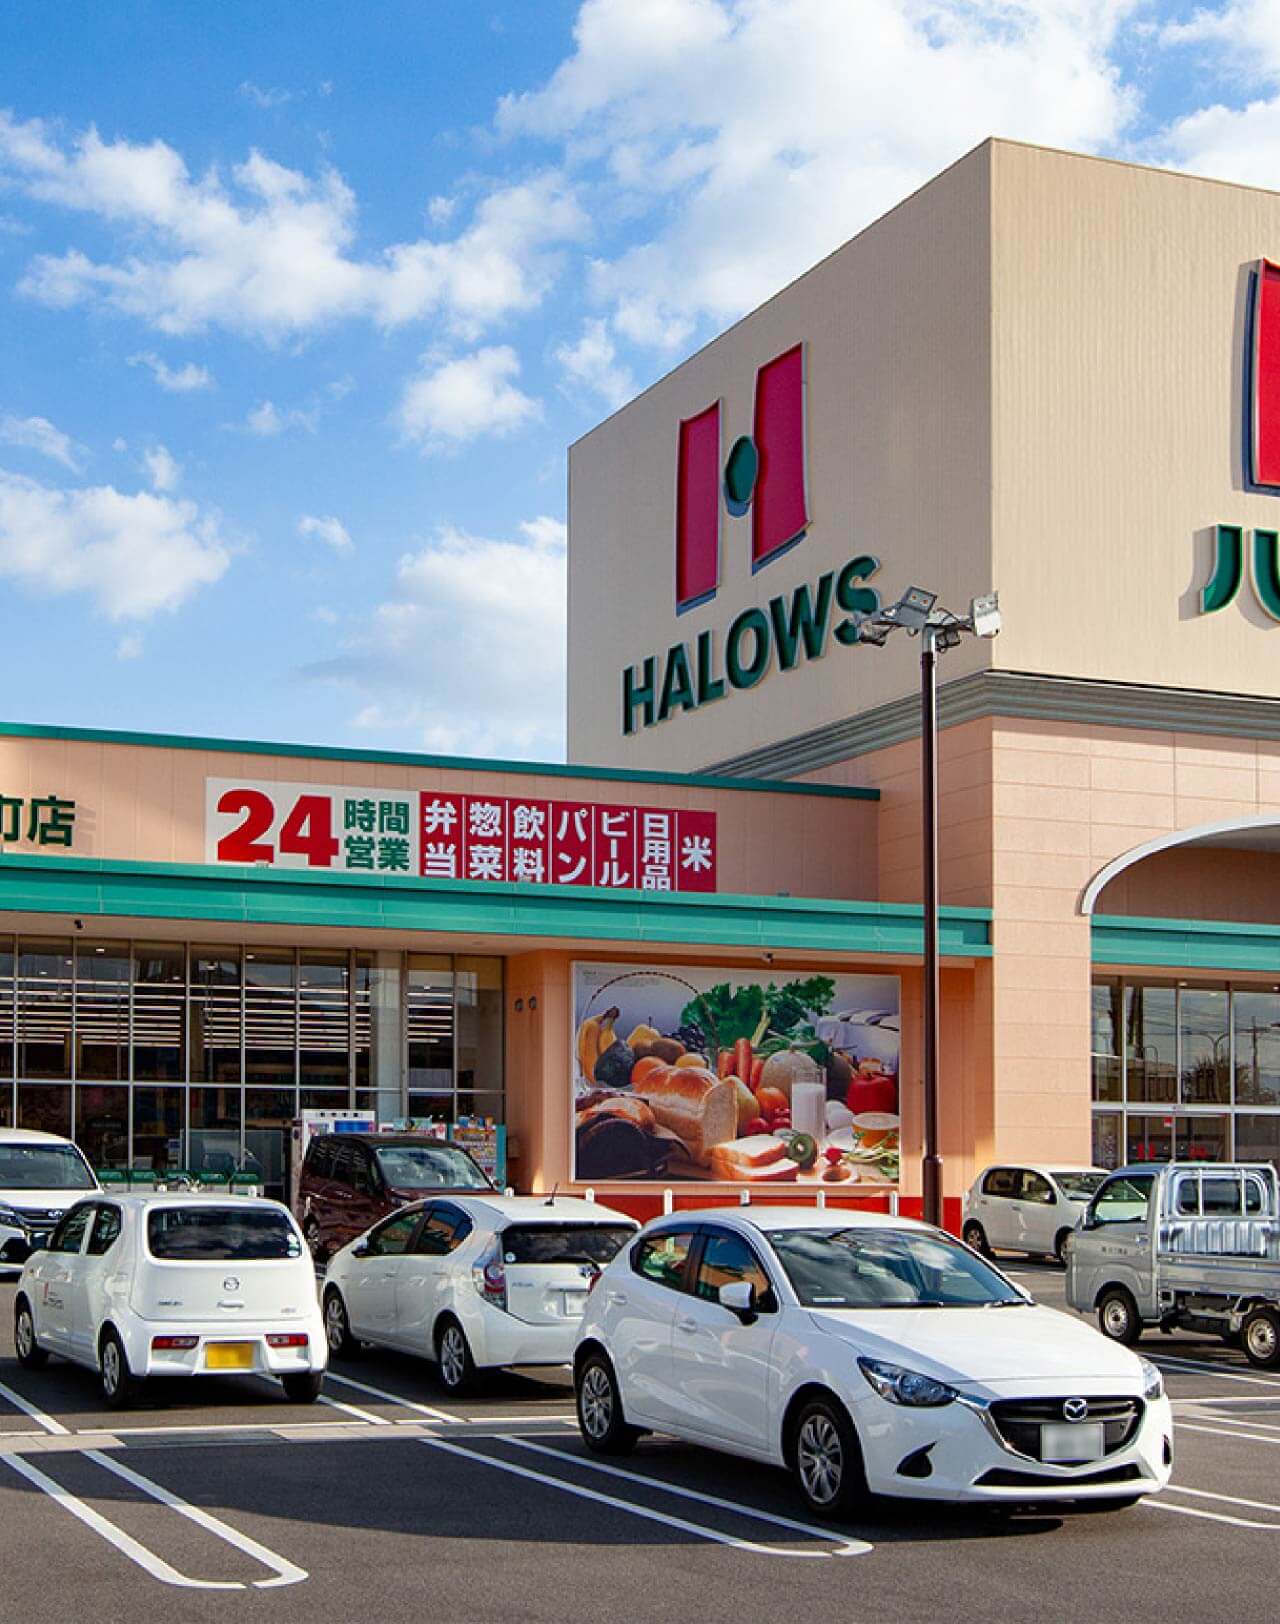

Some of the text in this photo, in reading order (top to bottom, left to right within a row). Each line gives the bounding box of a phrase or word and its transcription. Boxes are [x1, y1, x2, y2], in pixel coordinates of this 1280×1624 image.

[621, 555, 881, 736] HALOWS
[217, 788, 339, 866] 24
[344, 798, 410, 835] 時間
[344, 836, 410, 873] 営業
[424, 799, 458, 879] 弁当
[469, 801, 503, 881] 惣菜
[512, 802, 546, 883] 飲料
[556, 806, 588, 885] パン
[600, 811, 630, 888] ビール
[641, 813, 672, 891] 日用品
[681, 836, 713, 873] 米
